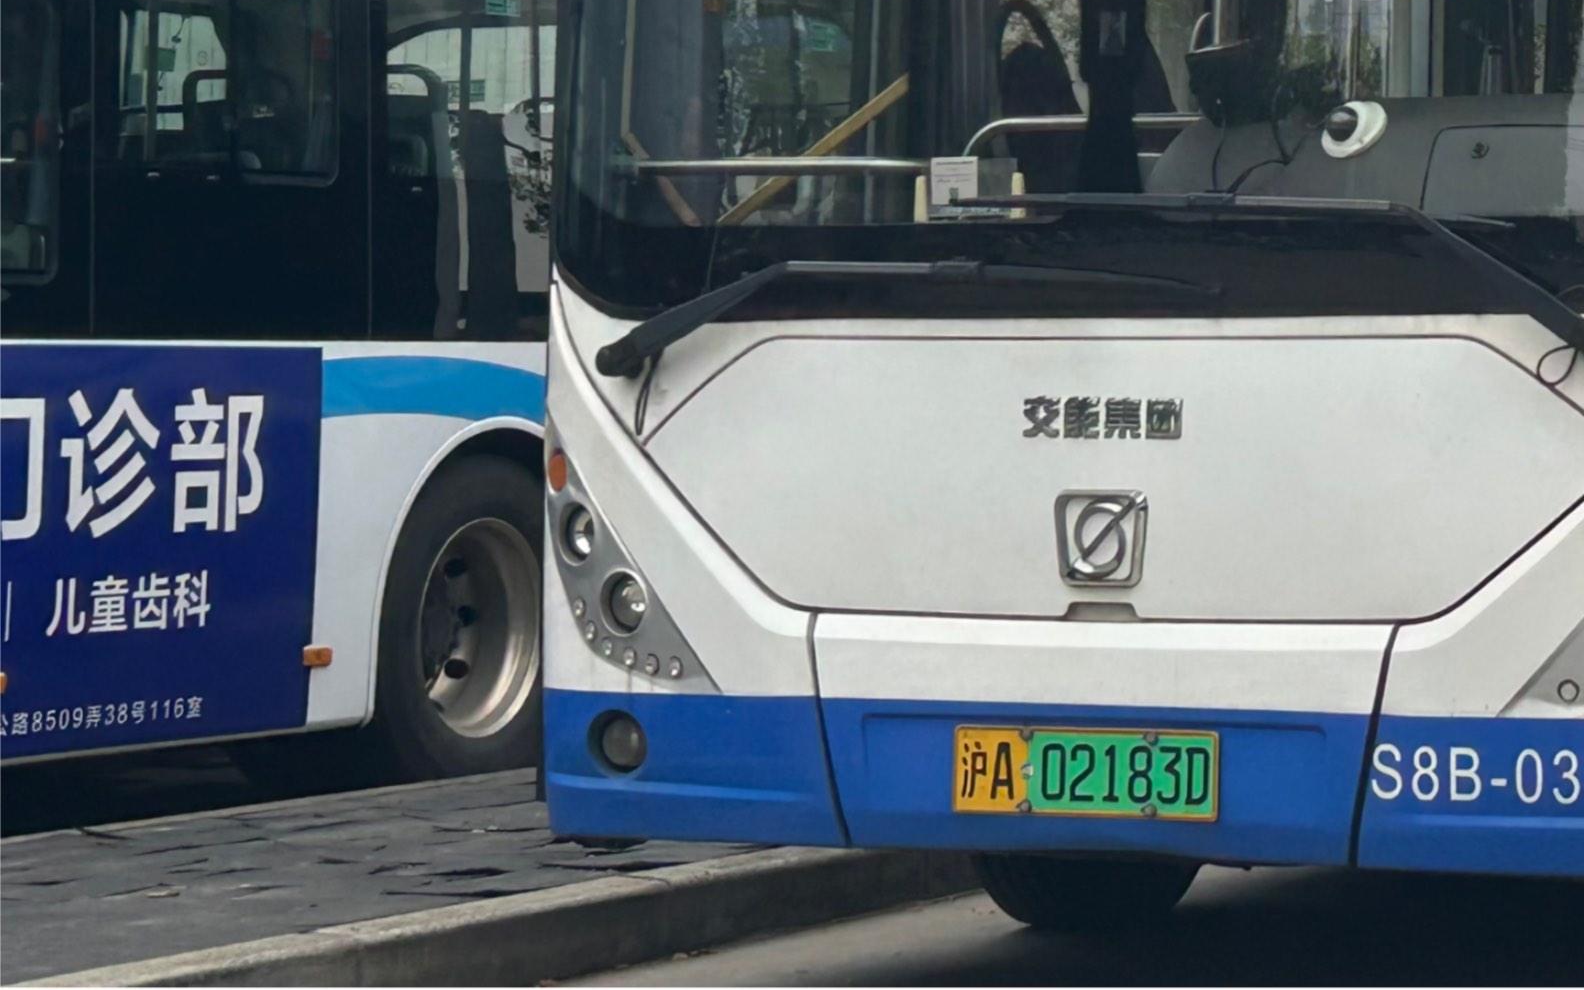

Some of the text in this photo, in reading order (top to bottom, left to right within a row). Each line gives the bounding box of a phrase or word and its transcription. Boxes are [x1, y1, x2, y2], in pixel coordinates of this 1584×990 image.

[1021, 395, 1184, 440] 交能集团
[45, 570, 211, 637] 儿童齿科
[961, 741, 1211, 807] 沪A 02183D
